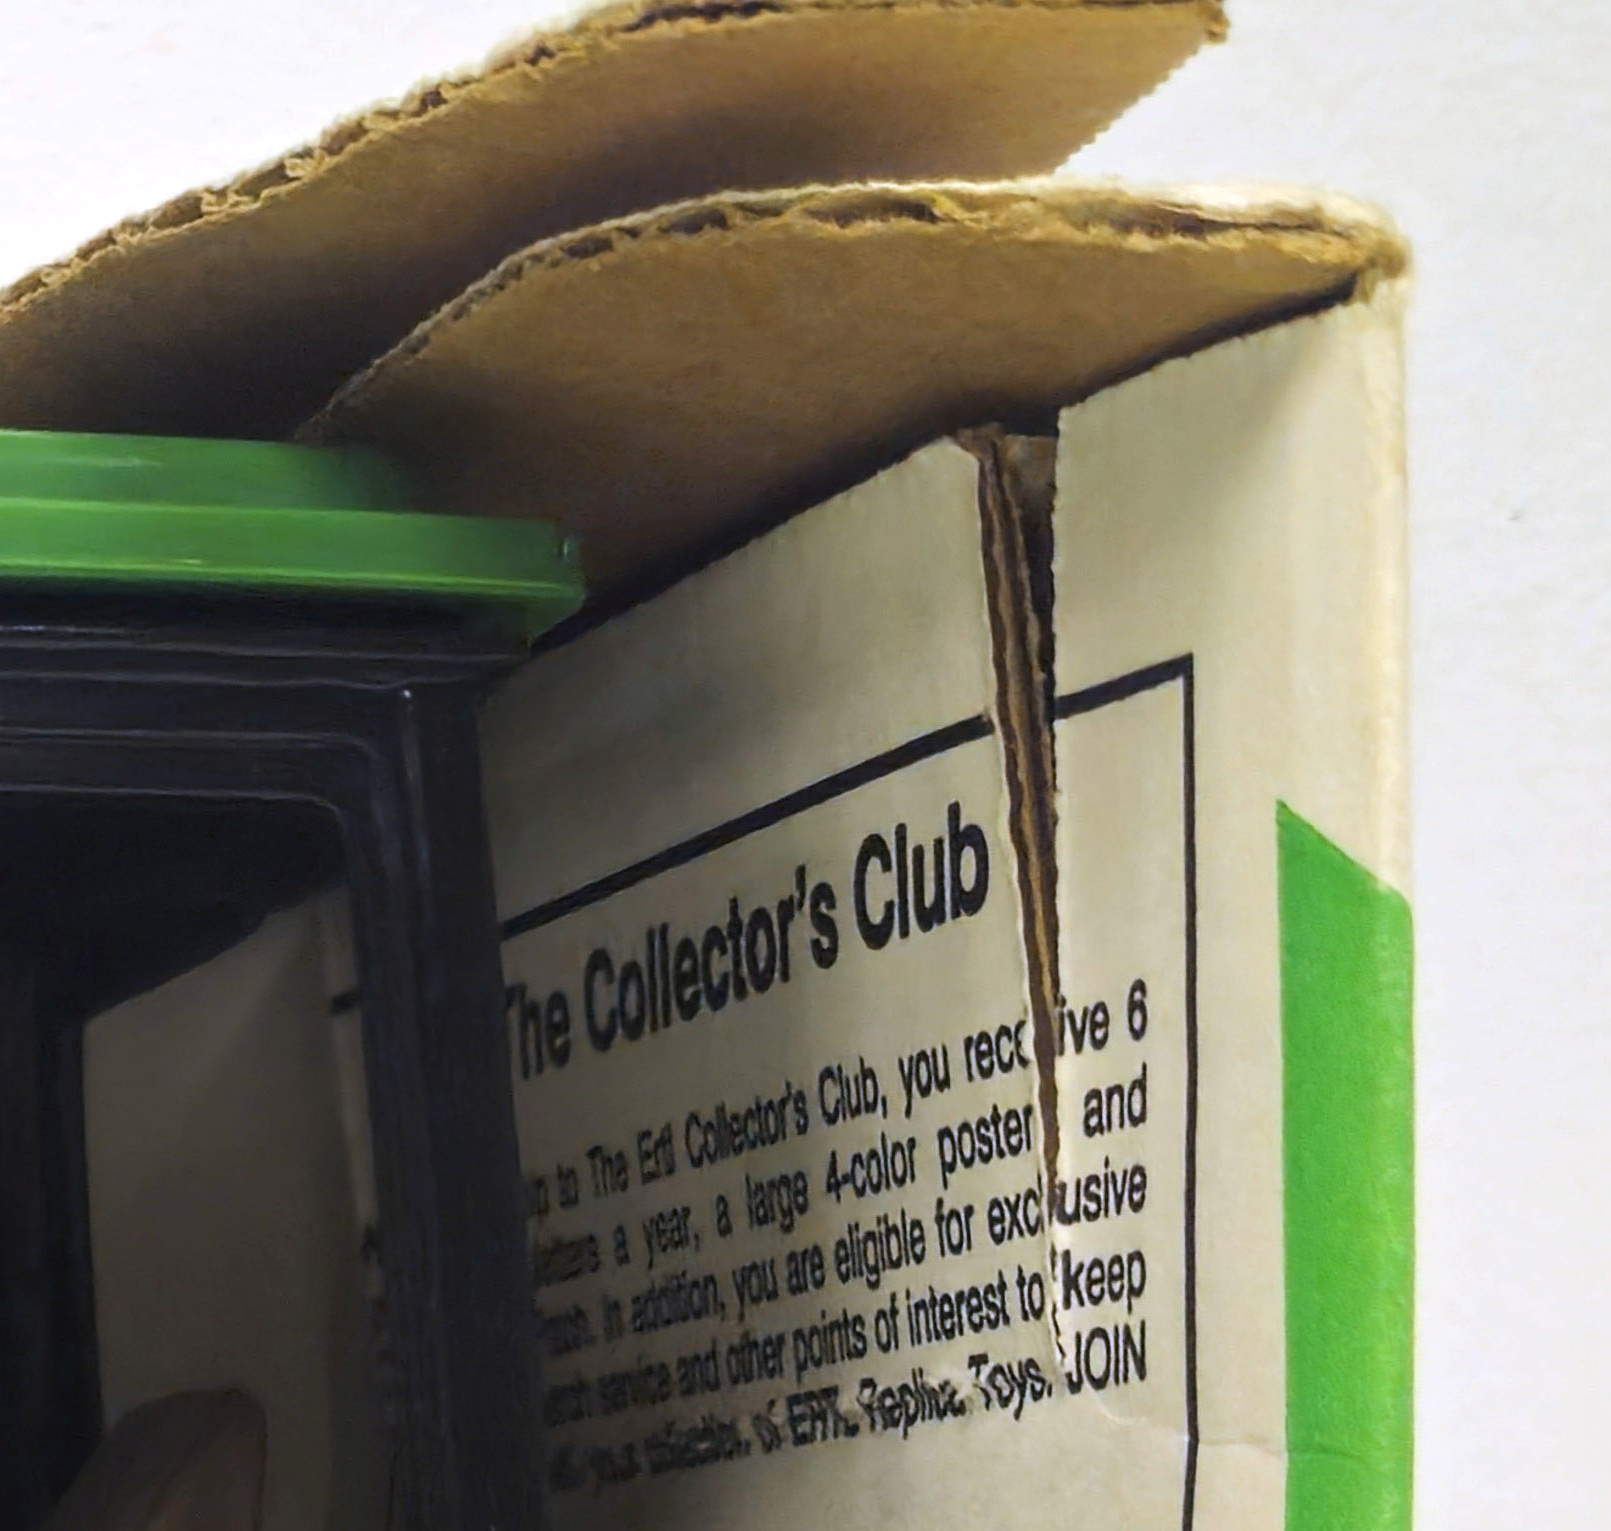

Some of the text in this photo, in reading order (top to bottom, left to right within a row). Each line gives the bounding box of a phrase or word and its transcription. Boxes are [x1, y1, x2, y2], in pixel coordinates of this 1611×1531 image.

[584, 864, 838, 1052] Collector's
[854, 801, 989, 950] Club
[586, 1144, 628, 1197] The
[685, 1080, 808, 1168] Collector's
[819, 1056, 887, 1125] Club,
[899, 1044, 950, 1119] you
[1128, 979, 1147, 1041] 6
[643, 1206, 700, 1269] year,
[716, 1194, 733, 1238] a
[745, 1171, 809, 1234] large
[826, 1131, 916, 1203] 4-color
[938, 1103, 1033, 1190] poster
[1083, 1062, 1147, 1138] and
[678, 1338, 720, 1397] and
[727, 1331, 785, 1388] other
[793, 1308, 867, 1386] points
[874, 1292, 899, 1352] of
[907, 1269, 1009, 1347] interest
[1017, 1264, 1044, 1321] to
[1062, 1249, 1146, 1314] keep
[732, 1257, 778, 1323] you
[786, 1244, 825, 1296] are
[835, 1208, 926, 1290] eligible
[935, 1197, 974, 1257] for
[1066, 1320, 1147, 1394] JOIN
